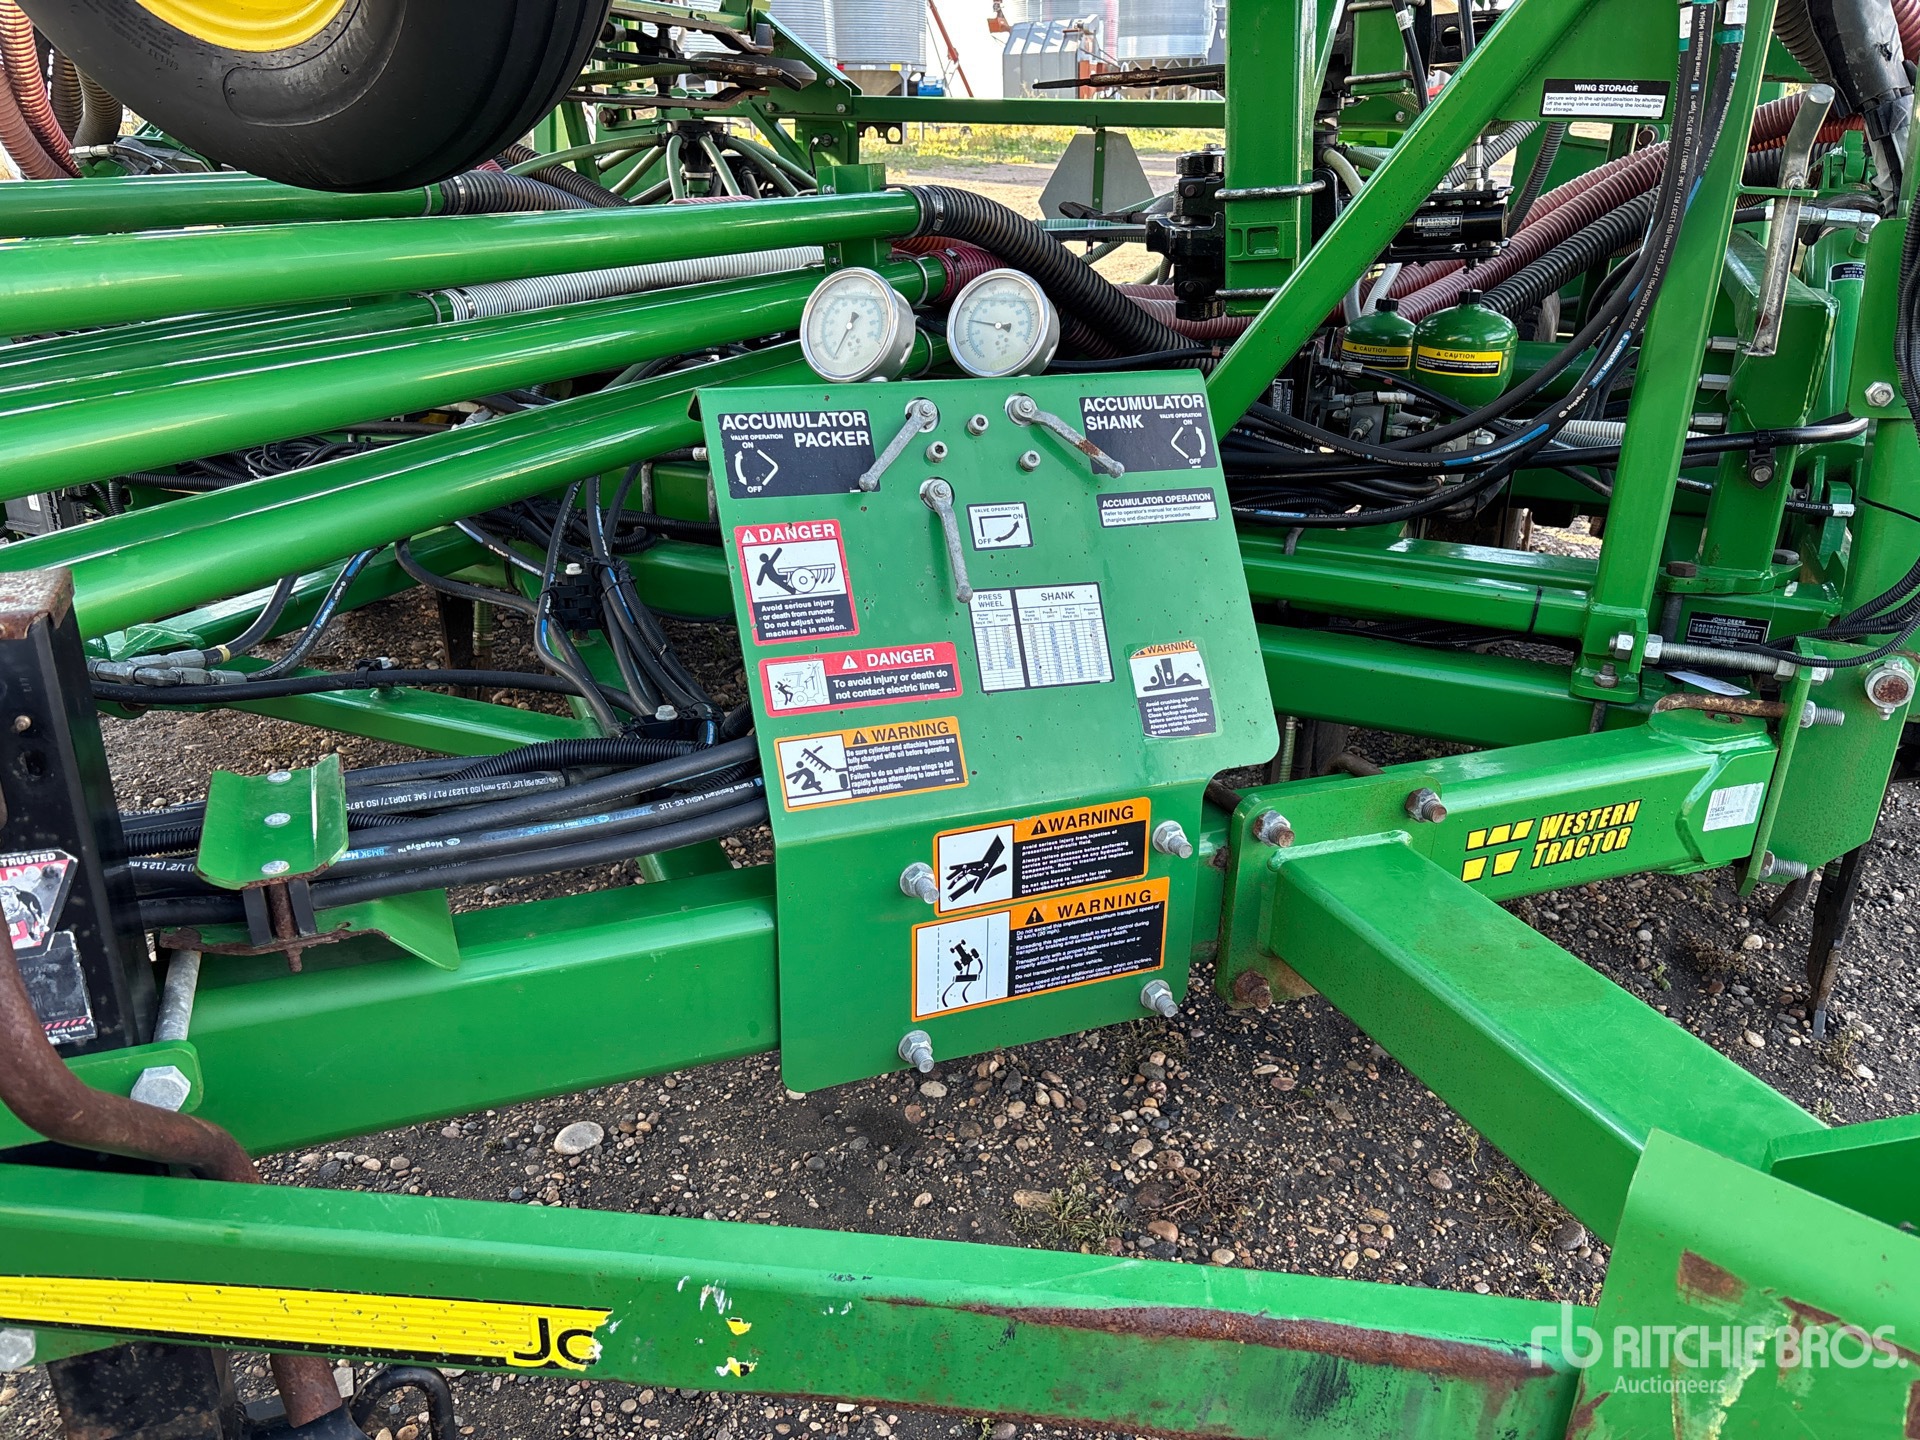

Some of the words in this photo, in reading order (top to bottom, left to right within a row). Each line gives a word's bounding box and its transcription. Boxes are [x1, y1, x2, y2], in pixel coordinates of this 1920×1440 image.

[1084, 395, 1204, 412] ACCUMULATOR
[722, 412, 867, 430] ACCUMULATOR
[1086, 414, 1144, 430] SHANK
[794, 431, 870, 448] PACKER
[1103, 497, 1163, 508] ACCUMULATOR
[1165, 493, 1211, 502] OPERATION
[759, 524, 835, 542] DANGER
[1041, 591, 1075, 601] SHANK
[762, 604, 783, 612] Avoid
[808, 608, 835, 616] runover.
[766, 629, 798, 638] machine
[819, 624, 847, 632] motion.
[791, 619, 814, 627] adjust
[1147, 641, 1196, 654] WARNING
[866, 648, 935, 667] DANGER
[833, 680, 846, 688] To
[848, 677, 872, 686] avoid
[873, 675, 898, 685] injury
[911, 671, 935, 680] death
[937, 669, 948, 677] do
[836, 691, 851, 699] not
[852, 687, 885, 697] contact
[887, 684, 918, 694] electric
[920, 682, 940, 691] lines
[872, 721, 949, 742] WARNING
[1048, 805, 1134, 832] WARNING
[1538, 801, 1641, 842] WESTERN
[1531, 827, 1632, 869] TRACTOR
[2, 853, 56, 867] TRUSTED
[1058, 890, 1151, 918] WARNING
